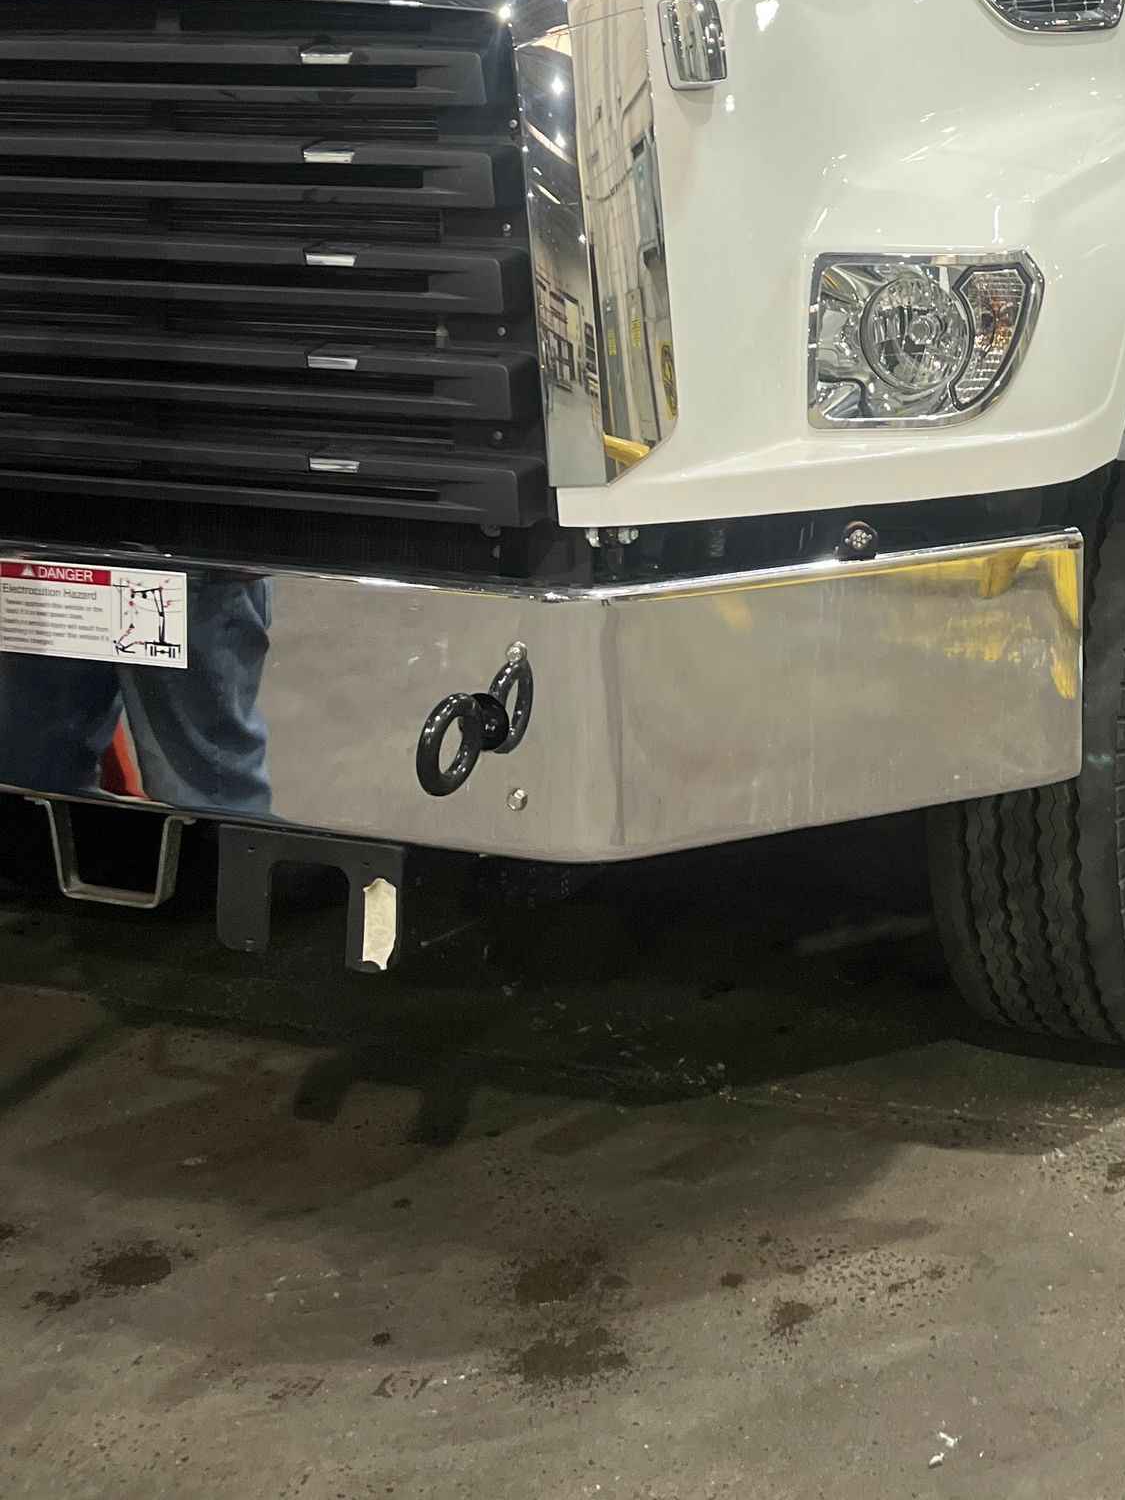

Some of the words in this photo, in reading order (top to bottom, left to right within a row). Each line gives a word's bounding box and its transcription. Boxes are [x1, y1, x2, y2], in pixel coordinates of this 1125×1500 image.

[38, 566, 94, 582] DANGER
[2, 583, 61, 597] Electrocution
[63, 589, 97, 600] Hazard
